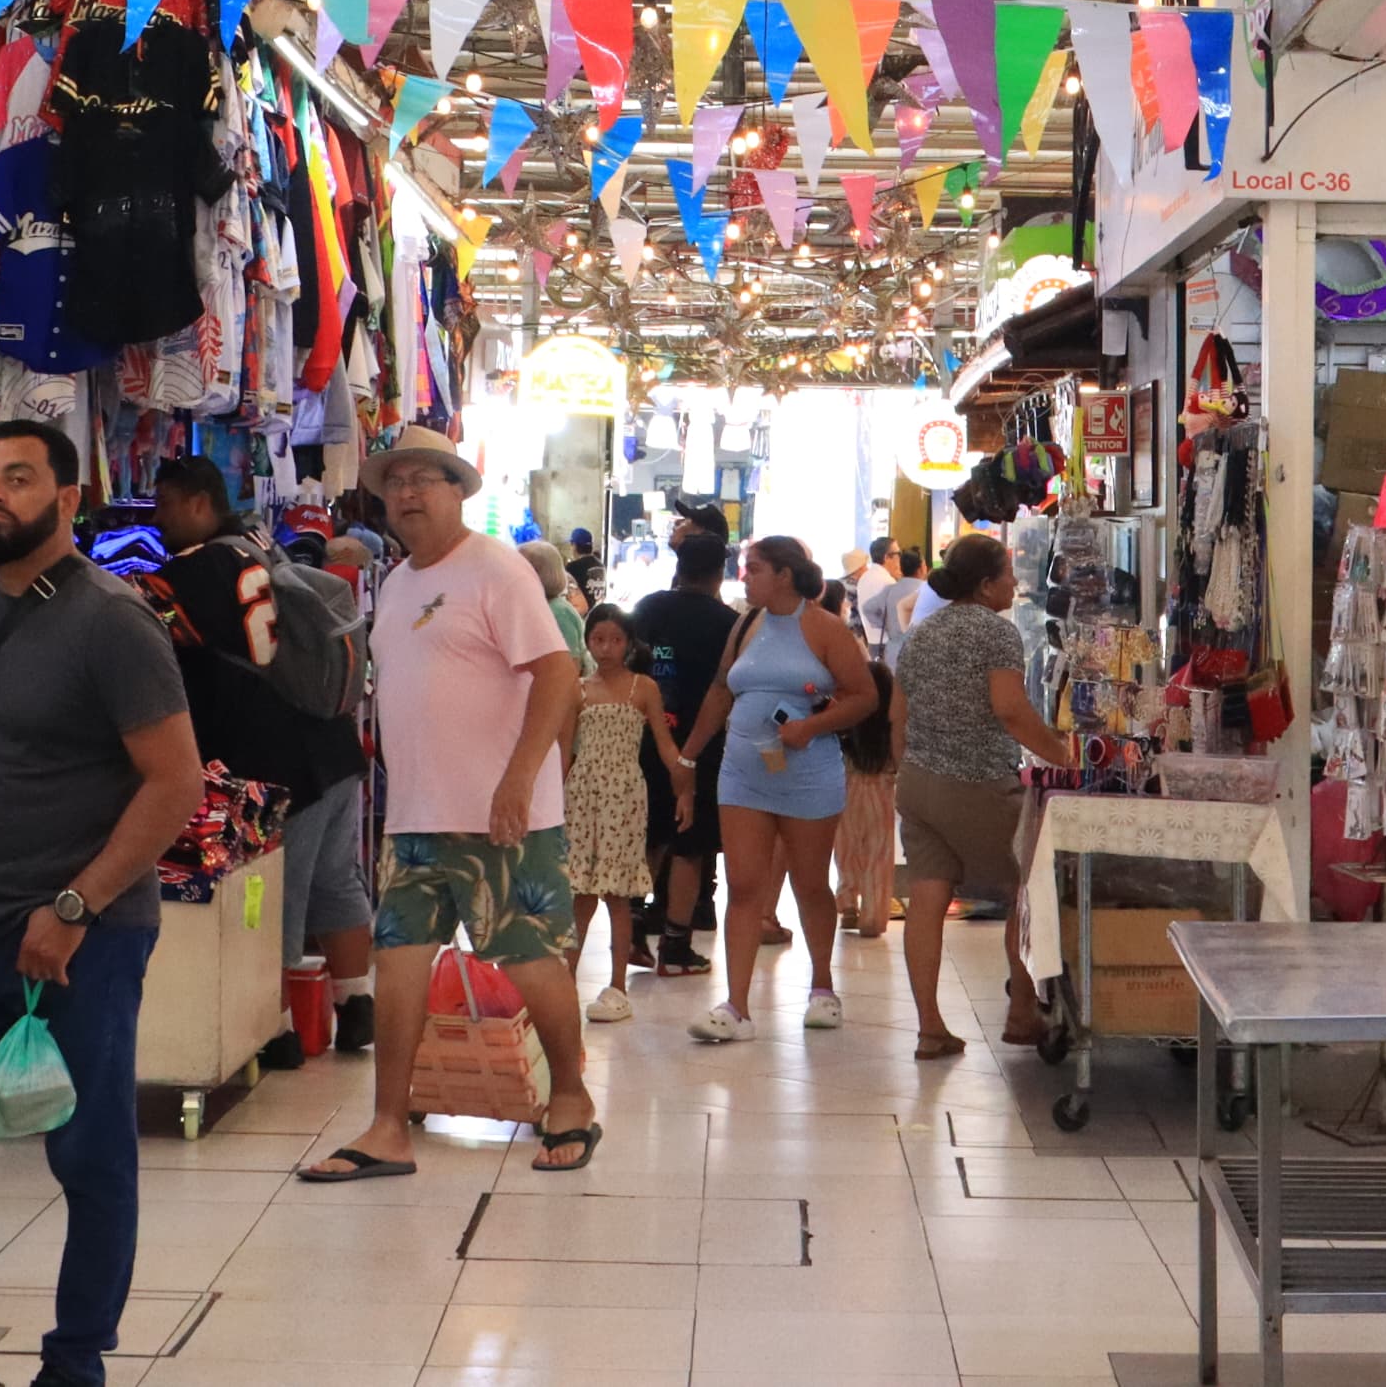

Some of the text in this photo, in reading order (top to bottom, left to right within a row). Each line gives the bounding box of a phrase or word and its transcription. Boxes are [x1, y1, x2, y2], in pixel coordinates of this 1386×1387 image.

[1232, 171, 1351, 192] Local C-36
[1086, 440, 1123, 450] TINTOR
